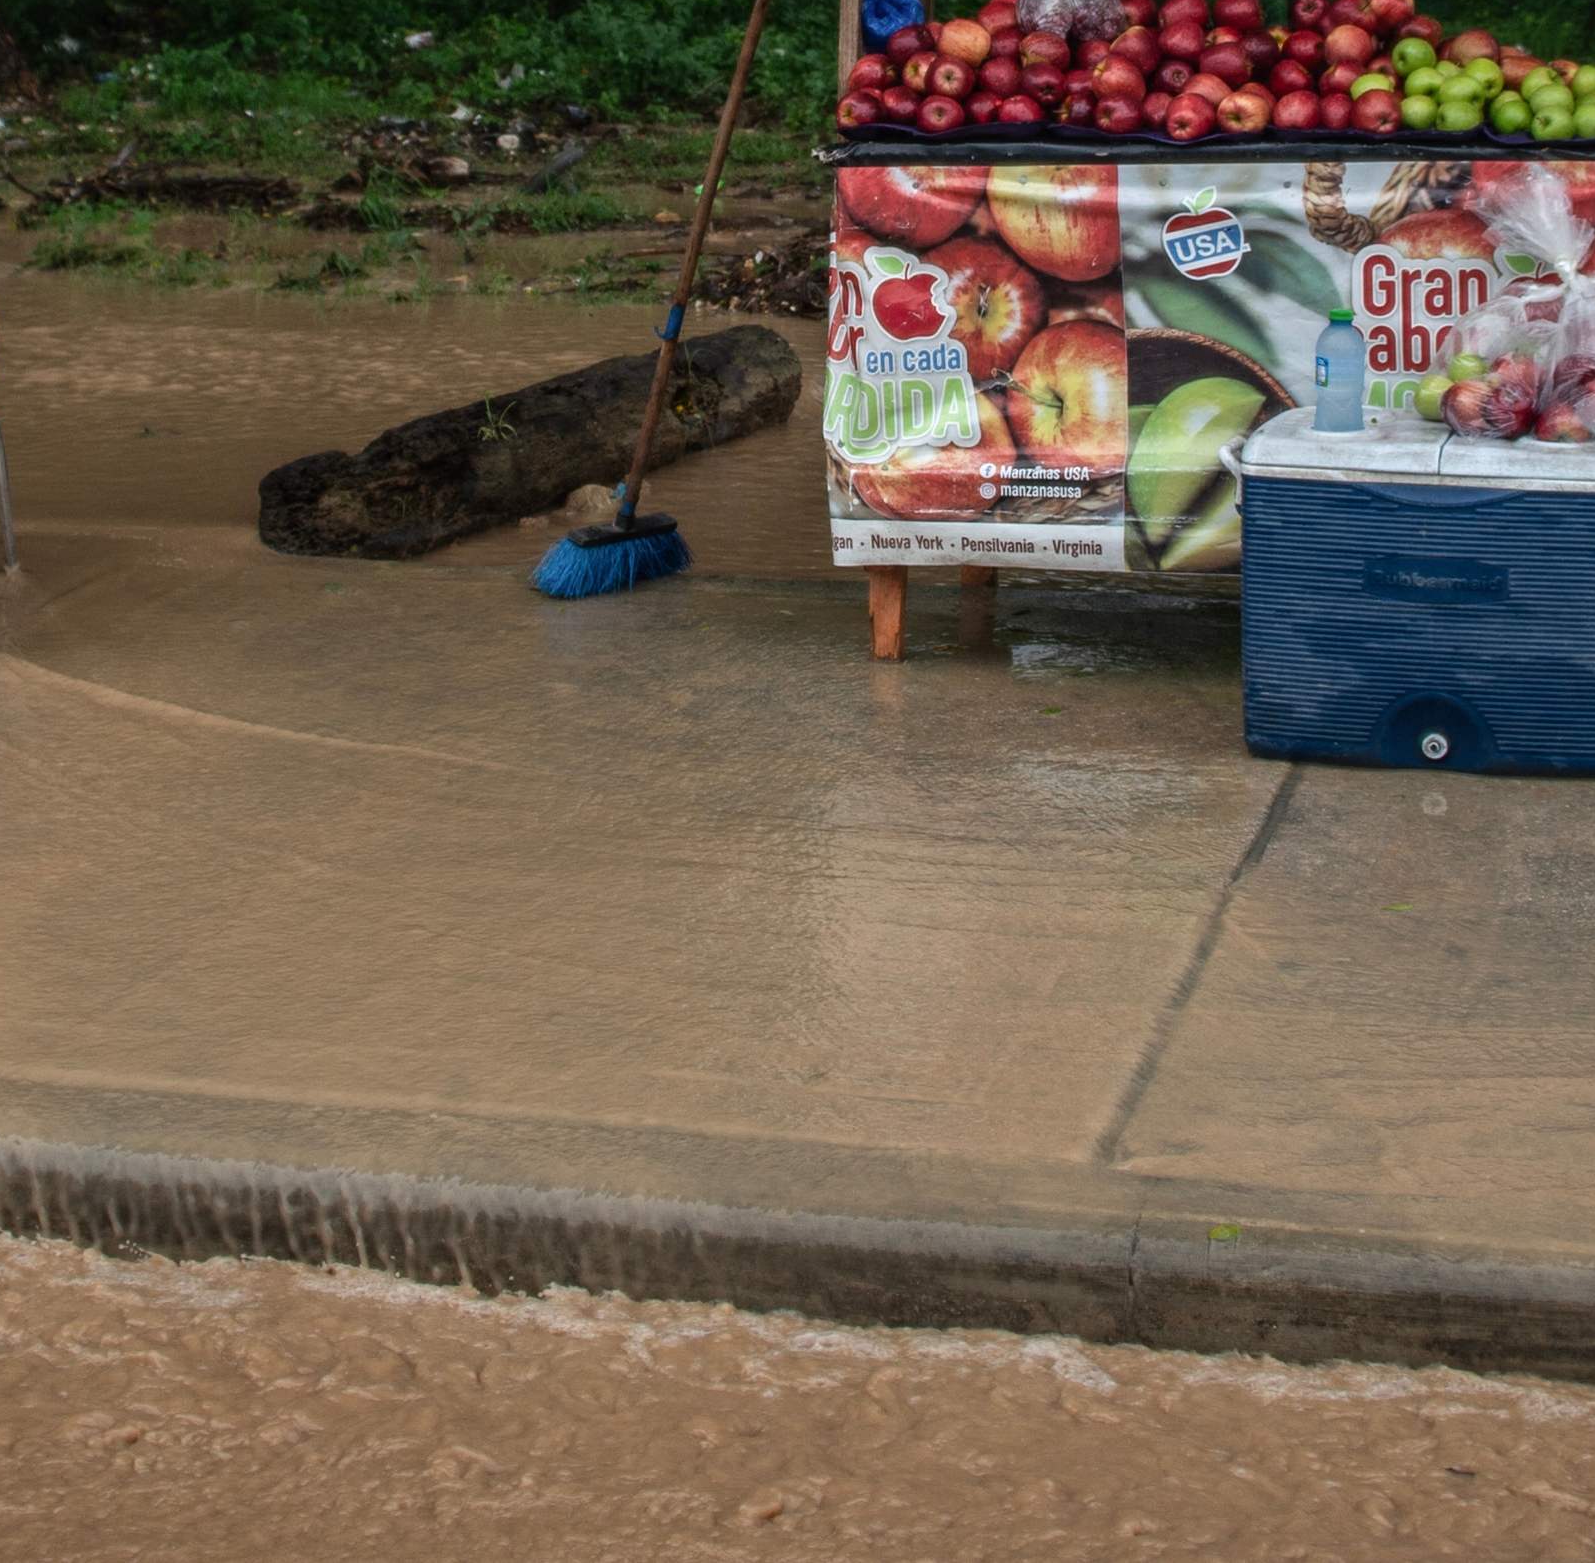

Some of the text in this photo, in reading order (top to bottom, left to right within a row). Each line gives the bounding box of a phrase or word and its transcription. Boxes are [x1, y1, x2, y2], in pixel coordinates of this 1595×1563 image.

[1174, 230, 1237, 262] USA
[1362, 253, 1489, 317] Gran
[866, 344, 961, 373] en cada
[1000, 465, 1090, 481] Manzanas USA
[1000, 484, 1081, 499] manzanasusa
[871, 534, 911, 550] Nueva
[915, 534, 943, 551] York
[961, 537, 1035, 553] Pensilvania
[1052, 539, 1102, 557] Virginia
